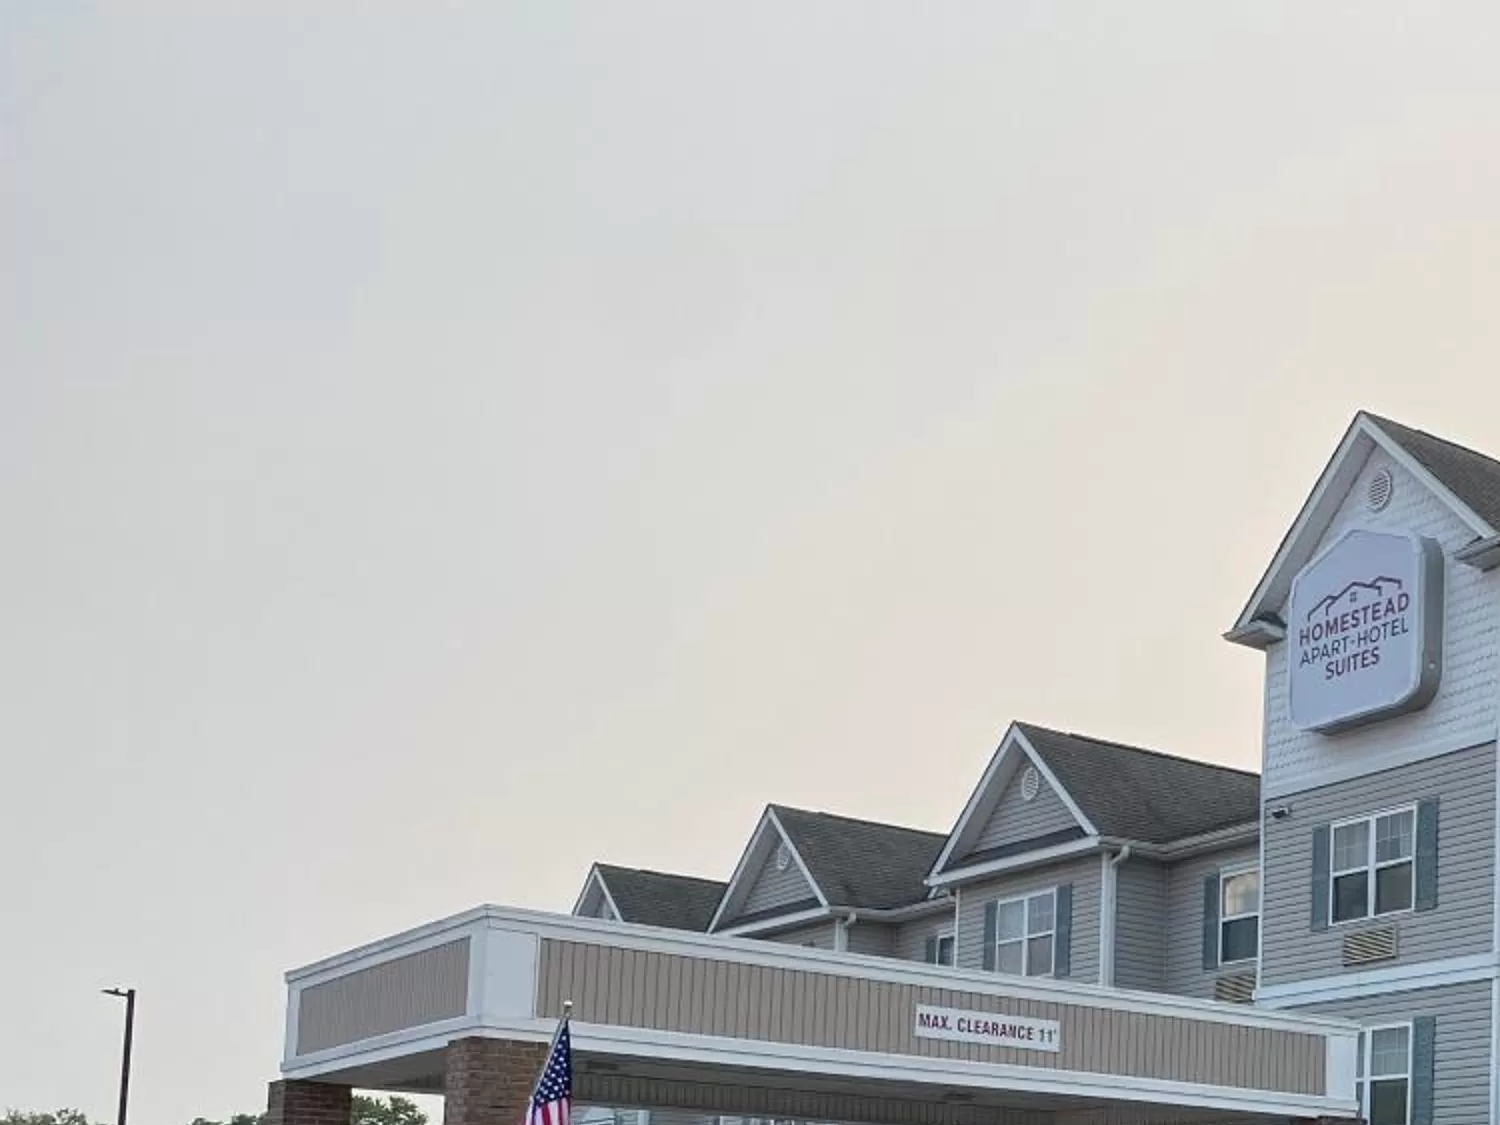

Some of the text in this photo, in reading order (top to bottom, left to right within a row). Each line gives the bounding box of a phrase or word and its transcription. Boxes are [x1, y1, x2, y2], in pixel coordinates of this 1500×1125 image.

[1299, 593, 1409, 647] HOMESTEAD
[1299, 617, 1409, 669] APART-HOTEL
[1325, 647, 1380, 681] SUITES
[918, 1013, 953, 1030] MAX.
[957, 1017, 1034, 1041] CLEARANCE
